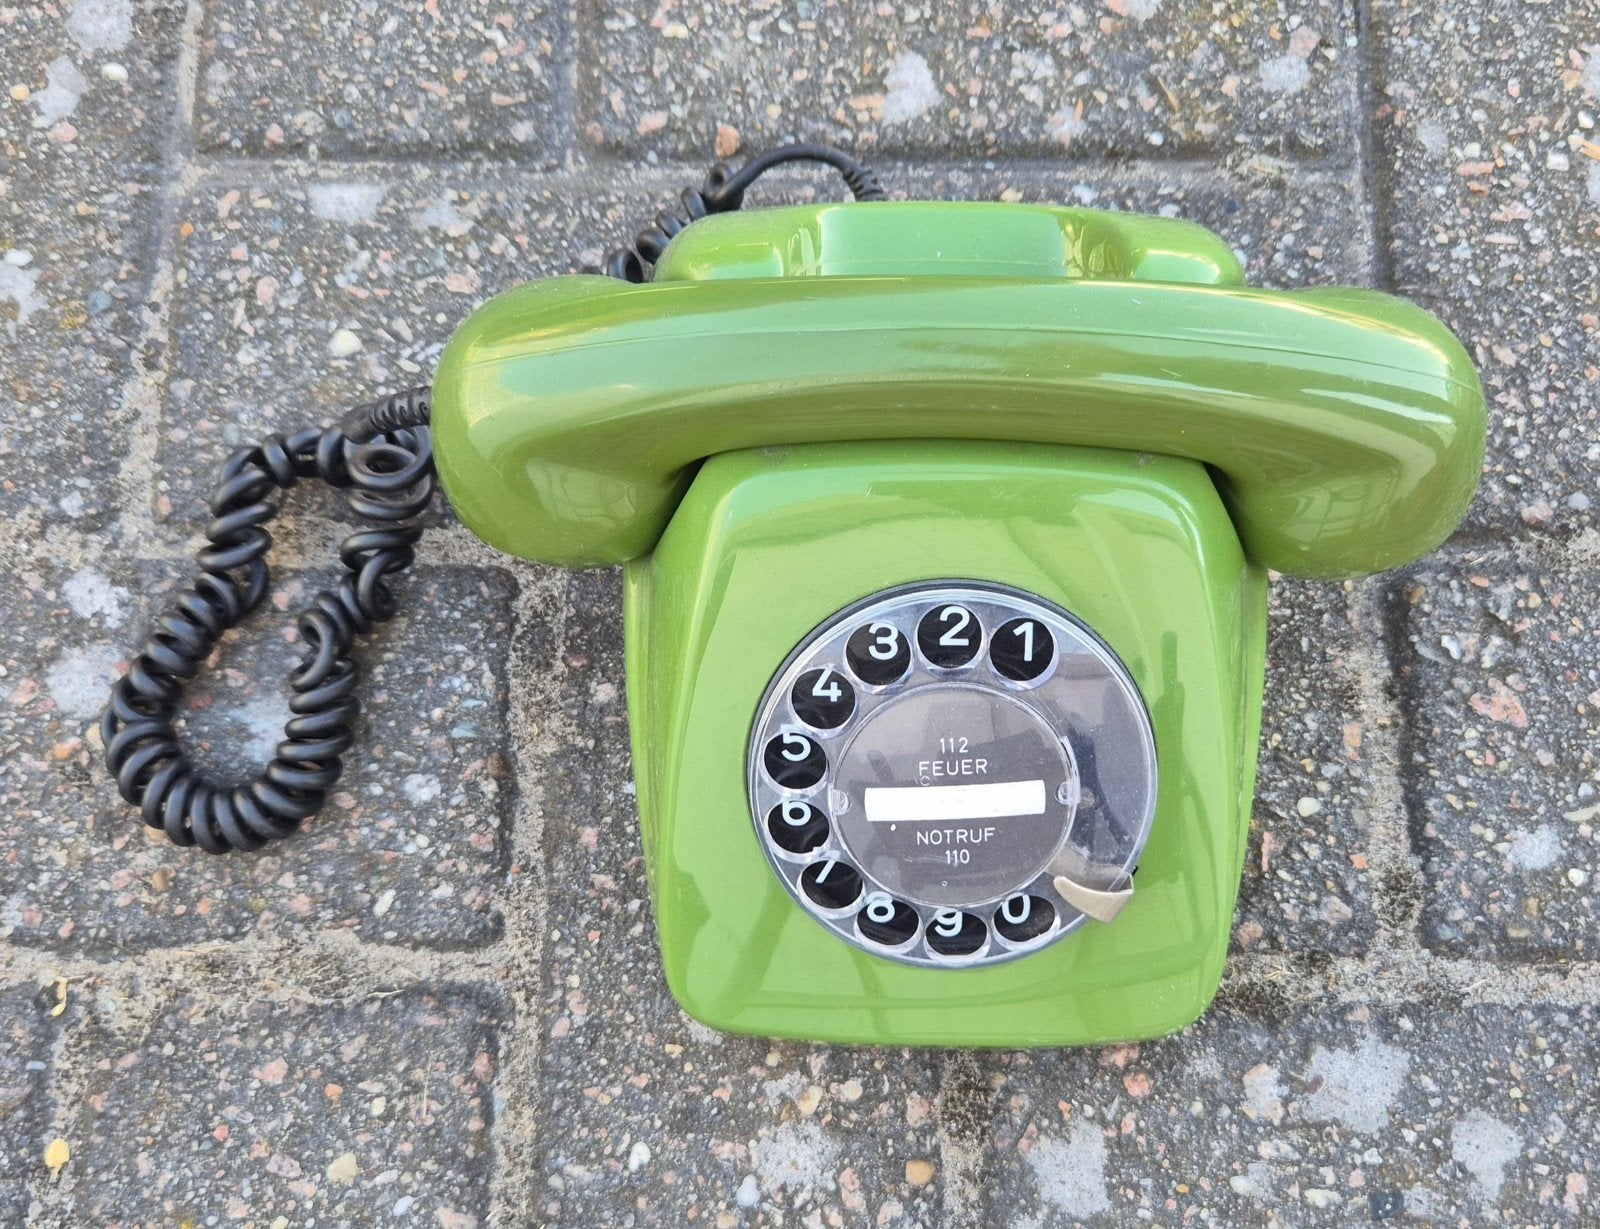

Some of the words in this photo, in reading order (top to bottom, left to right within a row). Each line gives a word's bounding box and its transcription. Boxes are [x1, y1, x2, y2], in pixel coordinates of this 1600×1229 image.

[867, 622, 899, 660] 3
[938, 605, 970, 646] 2
[1012, 622, 1035, 662] 1
[812, 663, 842, 702] 4
[780, 724, 811, 762] 5
[939, 737, 969, 753] 112
[918, 759, 988, 776] FEUER
[781, 796, 811, 826] 6
[916, 827, 996, 845] NOTRUF
[813, 848, 840, 884] 7
[945, 849, 970, 865] 110
[865, 891, 896, 923] 8
[934, 906, 963, 937] 9
[1001, 892, 1031, 924] 0
